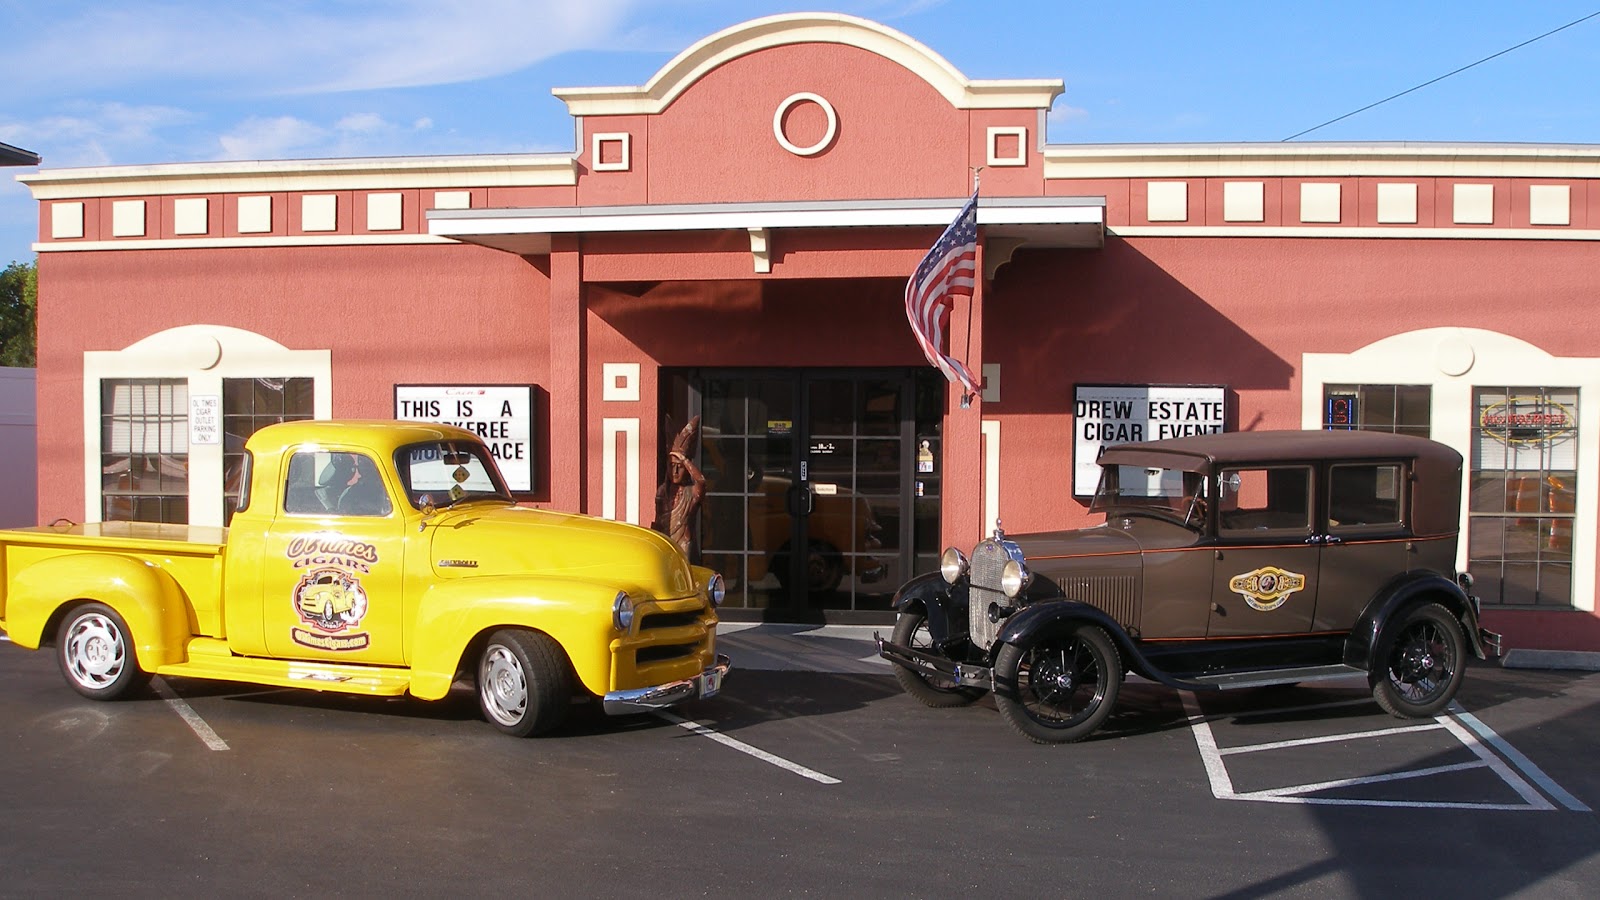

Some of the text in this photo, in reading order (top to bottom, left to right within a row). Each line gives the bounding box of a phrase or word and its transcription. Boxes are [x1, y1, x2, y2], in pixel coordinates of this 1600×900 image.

[401, 400, 513, 417] THIS IS A
[1076, 400, 1222, 420] DREW ESTATE
[1084, 422, 1221, 442] CIGAR EVENT
[294, 556, 370, 574] CIGARS
